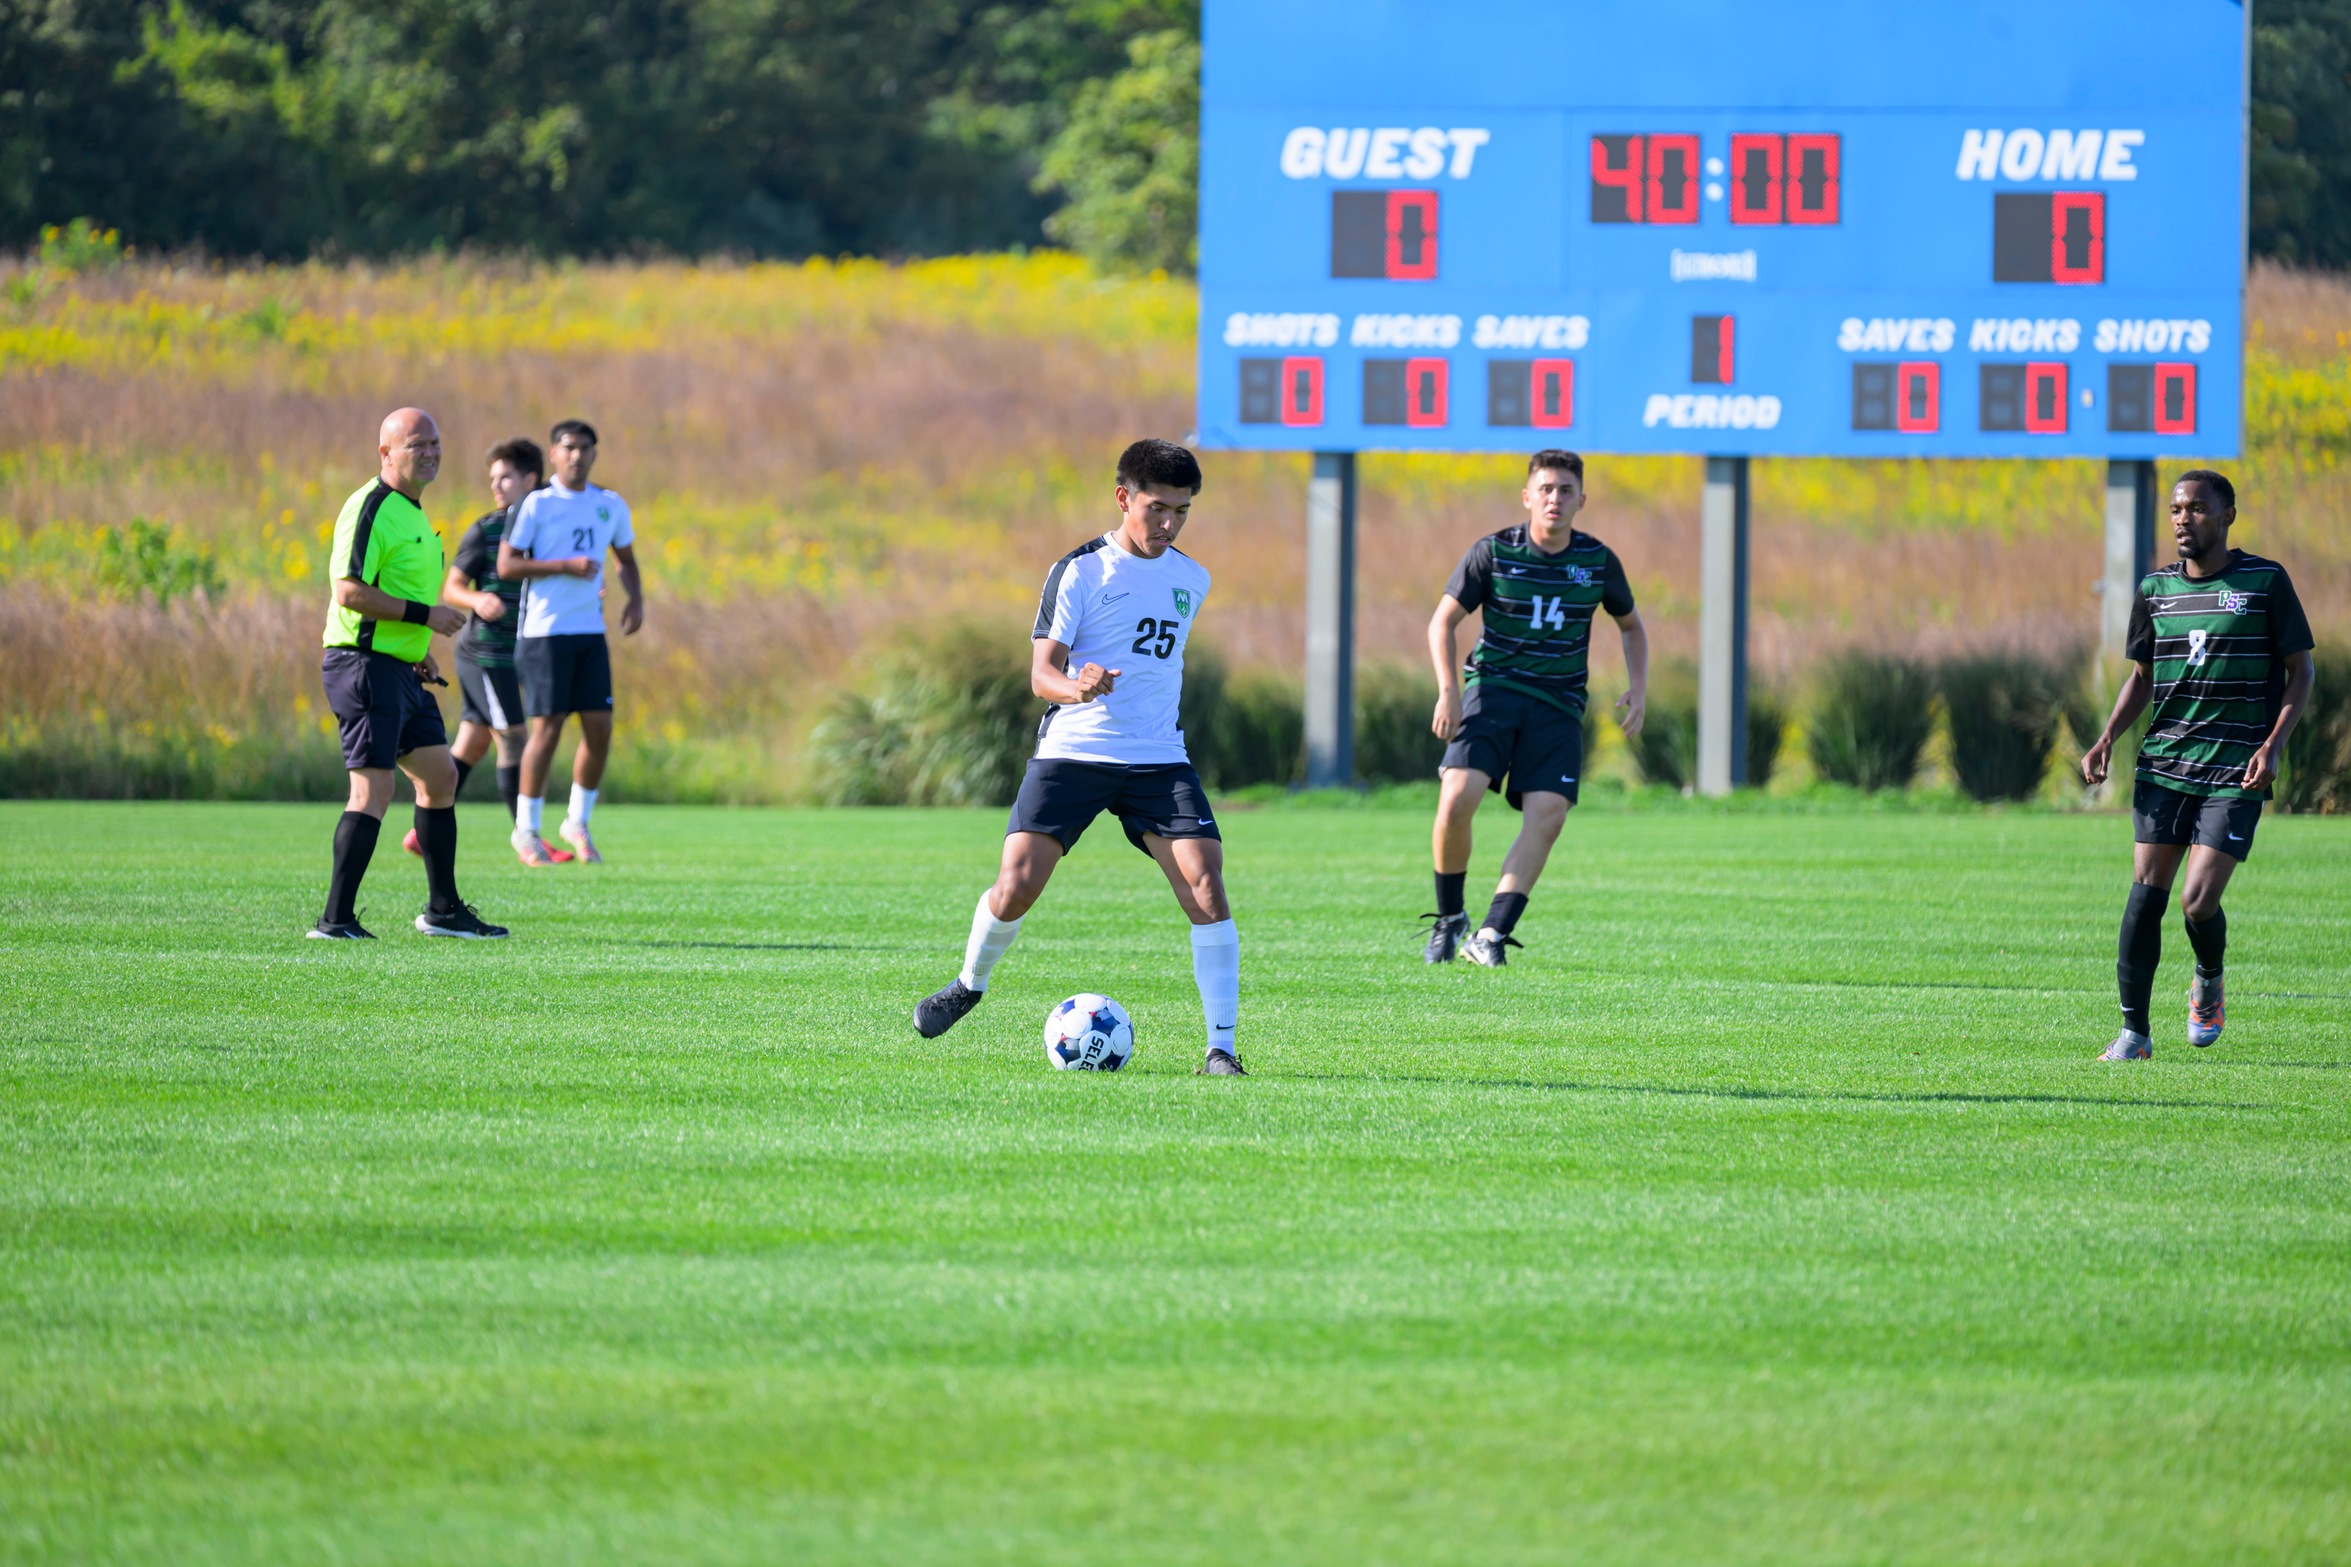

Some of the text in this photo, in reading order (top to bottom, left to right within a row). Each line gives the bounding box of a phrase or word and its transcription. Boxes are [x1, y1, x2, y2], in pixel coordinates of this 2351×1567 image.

[1280, 126, 1490, 180] GUEST
[1956, 128, 2145, 181] HOME
[1591, 134, 1840, 225] 40:00
[1385, 189, 1439, 280] 0
[2051, 191, 2105, 285] 0
[1223, 312, 1341, 348] SHOTS
[1350, 313, 1463, 349] KICKS
[1471, 314, 1591, 350] SAVES
[1837, 317, 1956, 352] SAVES
[1969, 318, 2081, 353] KICKS
[2094, 319, 2212, 353] SHOTS
[1281, 357, 1324, 426] 0
[1405, 358, 1449, 428] 0
[1530, 359, 1574, 429] 0
[1643, 394, 1782, 429] PERIOD
[1897, 362, 1940, 433] 0
[2025, 362, 2068, 434] 0
[2154, 362, 2196, 435] 0
[572, 527, 594, 552] 21
[1529, 594, 1565, 631] 14
[2218, 590, 2247, 615] PSC
[1131, 617, 1180, 660] 25
[2187, 629, 2207, 666] 8
[1078, 1035, 1105, 1072] SELE
